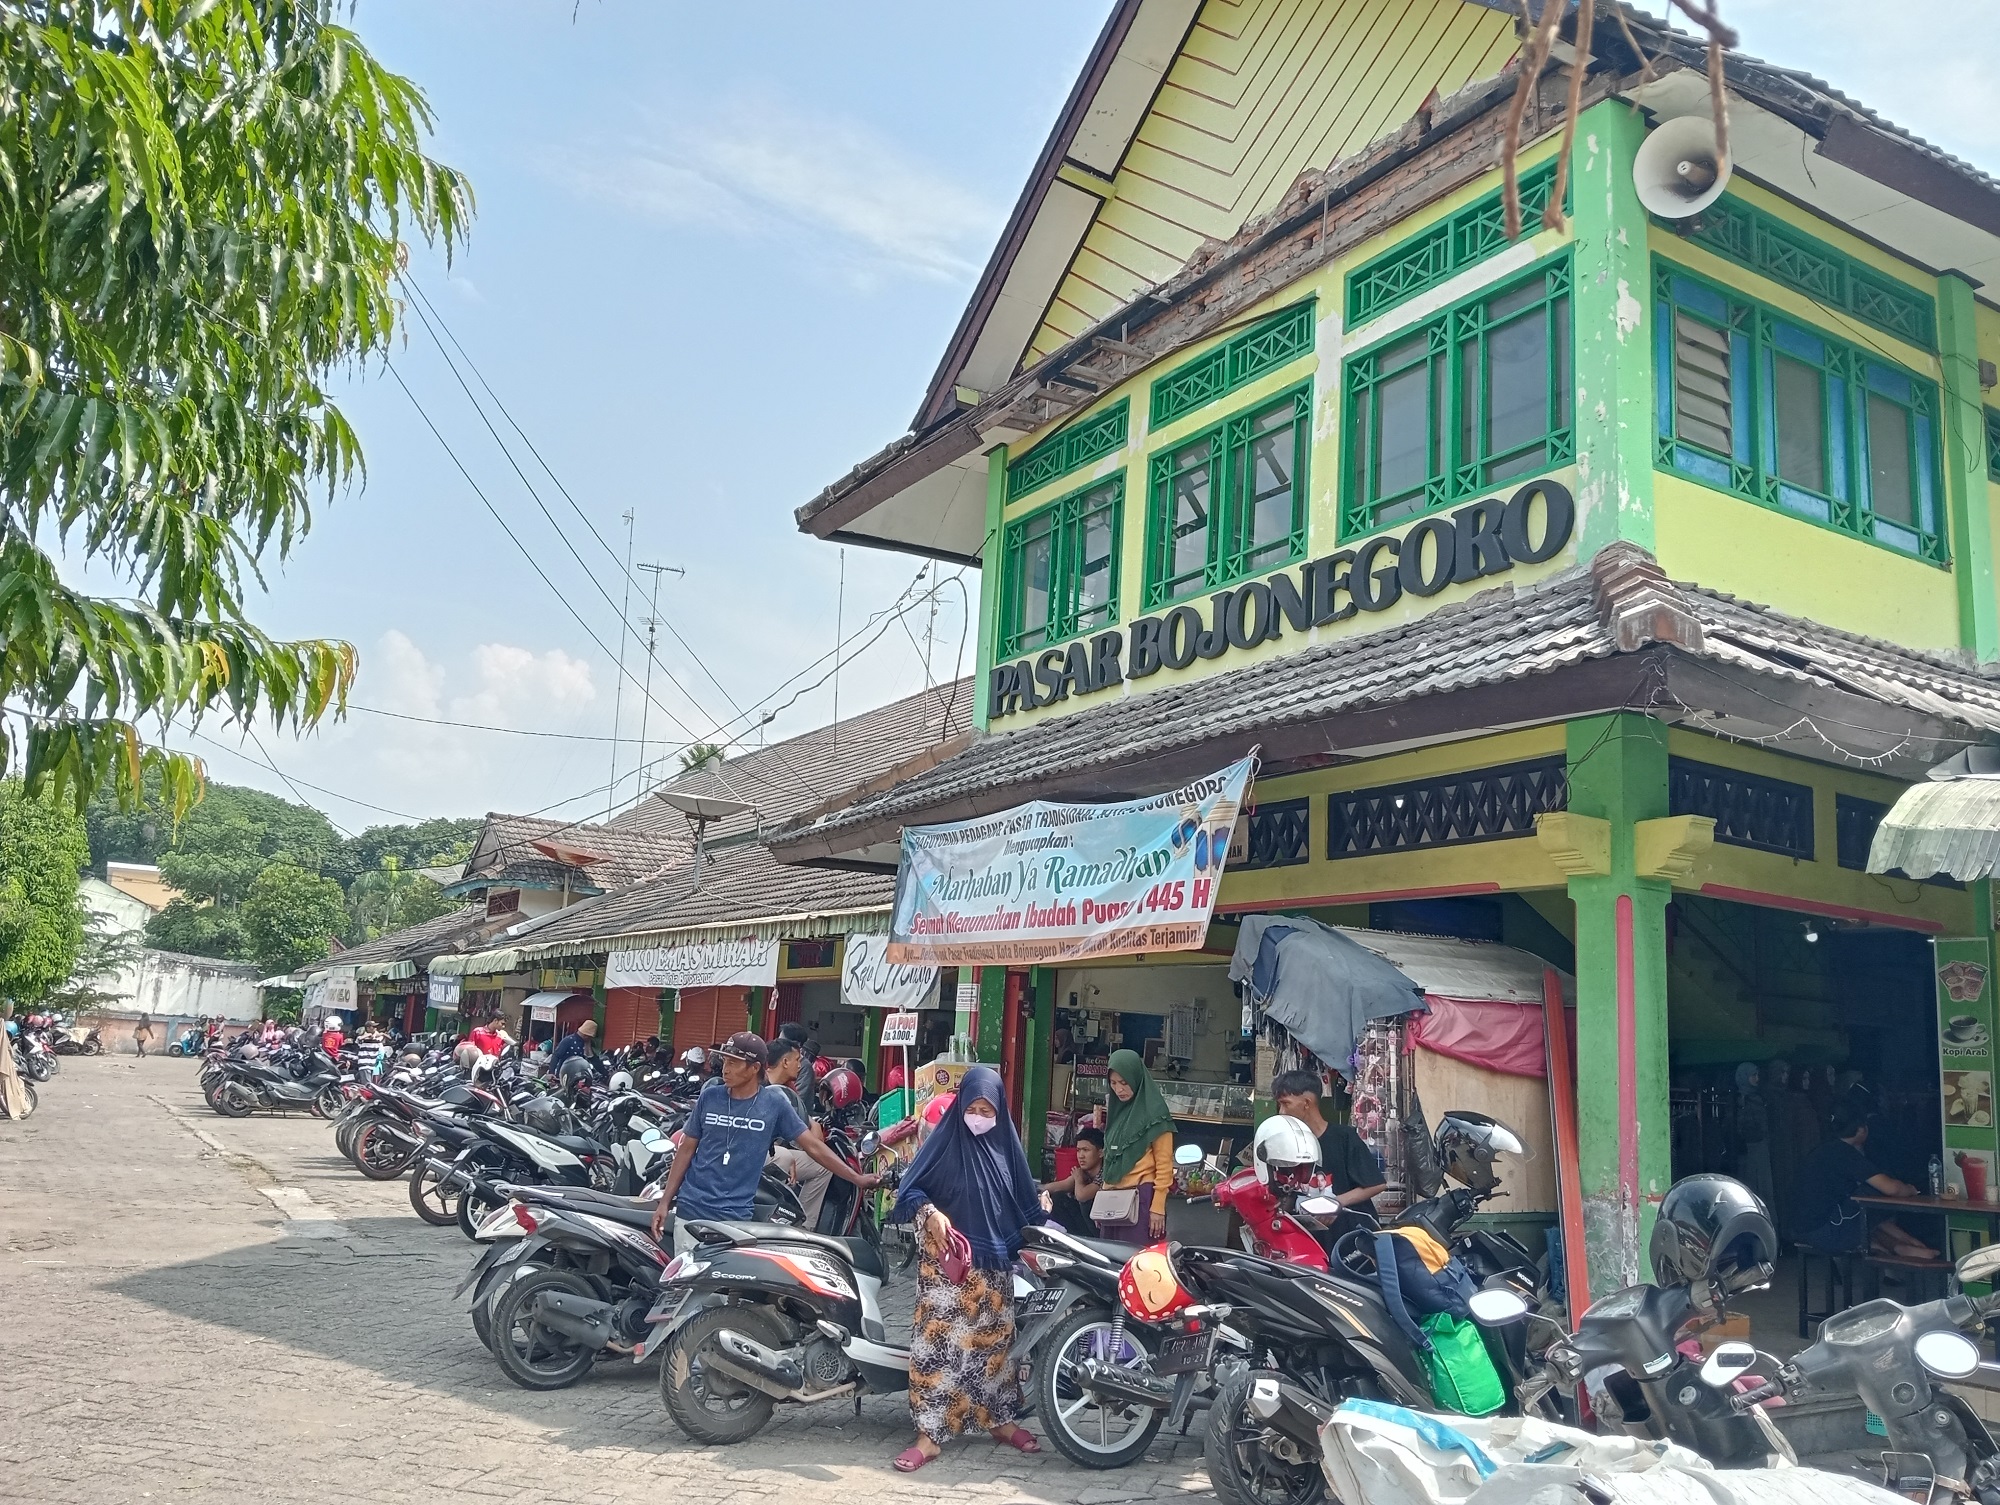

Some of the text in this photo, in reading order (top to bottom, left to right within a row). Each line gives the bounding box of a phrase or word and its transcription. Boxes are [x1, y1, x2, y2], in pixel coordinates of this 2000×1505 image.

[987, 478, 1575, 720] PASAR BOJONEGORO
[1003, 814, 1033, 836] PASAR
[1035, 807, 1097, 829] TRADISIONAL
[929, 847, 1171, 904] Marhaban Ya Ramadhan
[946, 904, 1022, 934] Menunaikan
[1023, 898, 1076, 929] Ibadah
[1191, 878, 1212, 909] H
[615, 948, 655, 972] TOKO
[655, 944, 702, 972] EMAS
[997, 945, 1013, 960] Kota
[1014, 941, 1057, 962] Bojonegoro
[1110, 931, 1148, 950] Kualitas
[896, 1015, 917, 1031] POCI
[1942, 1047, 1988, 1057] Kopi Arab
[778, 1206, 797, 1219] HONDA
